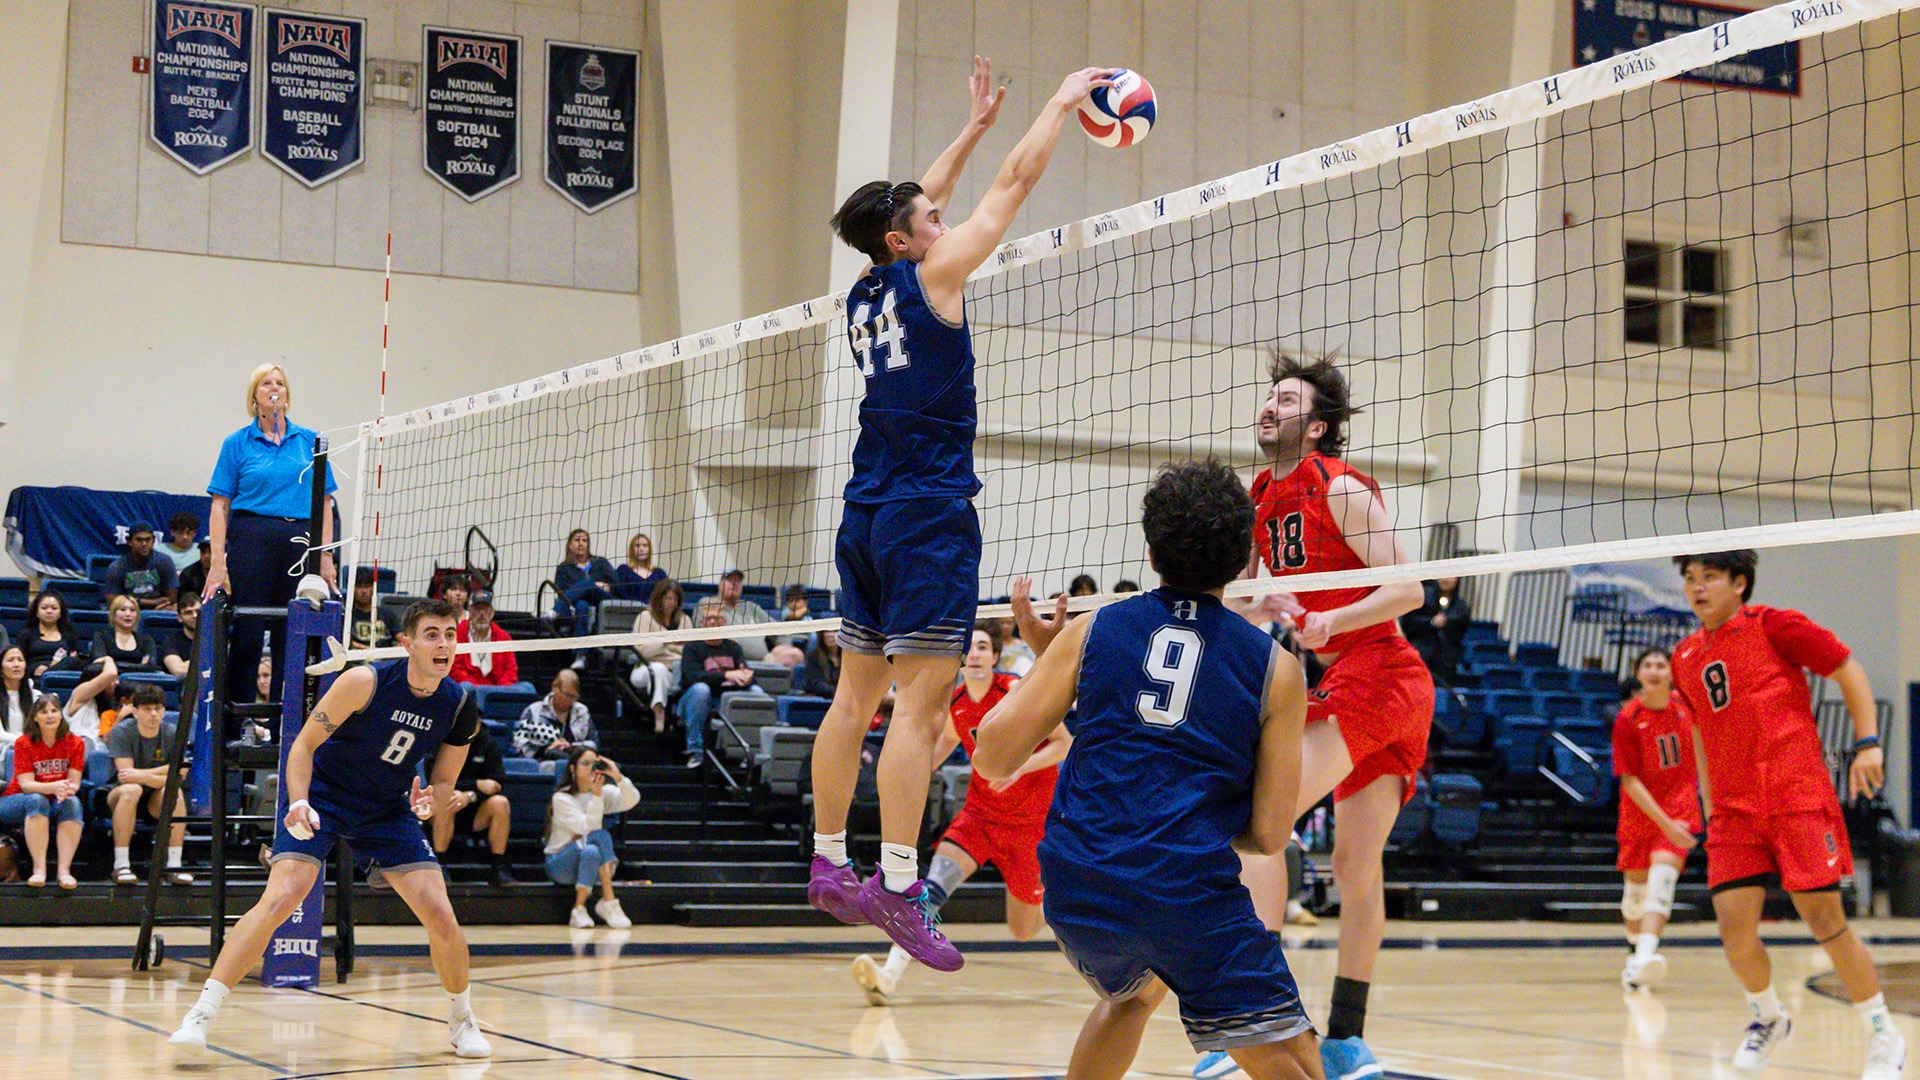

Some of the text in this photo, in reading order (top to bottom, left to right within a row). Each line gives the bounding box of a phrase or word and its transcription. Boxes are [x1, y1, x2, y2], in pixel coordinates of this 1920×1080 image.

[169, 8, 239, 40] NAIA
[1791, 1, 1843, 29] ROYALS
[281, 22, 348, 53] NAIA
[1712, 22, 1730, 53] H
[176, 41, 230, 58] NATIONAL
[441, 40, 505, 70] NAIA
[157, 52, 248, 73] CHAMPIONSHIPS
[289, 52, 339, 68] NATIONAL
[163, 66, 189, 77] BUTTE
[205, 70, 241, 82] BRACKET
[271, 61, 356, 82] CHAMPIONSHIPS
[1613, 57, 1656, 84] ROYALS
[187, 85, 217, 98] MEN'S
[271, 76, 305, 88] FAYETTE
[319, 81, 356, 93] BRACKET
[447, 78, 497, 94] NATIONAL
[1542, 77, 1562, 107] H
[170, 94, 233, 111] BASKETBALL
[279, 87, 347, 104] CHAMPIONS
[430, 89, 514, 108] CHAMPIONSHIPS
[574, 92, 610, 107] STUNT
[188, 108, 215, 120] 2024
[283, 109, 342, 127] BASEBALL
[443, 104, 473, 115] ANTONIO
[563, 103, 622, 121] NATIONALS
[437, 120, 501, 138] SOFTBALL
[556, 115, 610, 132] FULLERTON
[1455, 108, 1497, 131] ROYALS
[174, 131, 228, 148] ROYALS
[297, 123, 328, 137] 2024
[1395, 122, 1413, 148] H
[454, 135, 488, 150] 2024
[557, 135, 625, 152] SECOND PLACE
[287, 145, 339, 162] ROYALS
[579, 149, 602, 160] 2024
[1320, 148, 1357, 170] ROYALS
[446, 160, 496, 177] ROYALS
[1265, 161, 1281, 187] H
[566, 172, 615, 189] ROYALS
[1199, 184, 1227, 205] ROYALS
[1153, 197, 1165, 220] H
[1051, 228, 1062, 249] H
[849, 287, 911, 378] 44
[1266, 511, 1307, 571] 18
[1135, 624, 1205, 730] 9
[1701, 660, 1731, 713] 8
[390, 710, 433, 731] ROYALS
[381, 730, 415, 765] 8
[1656, 732, 1680, 769] 11
[273, 938, 318, 958] HIU
